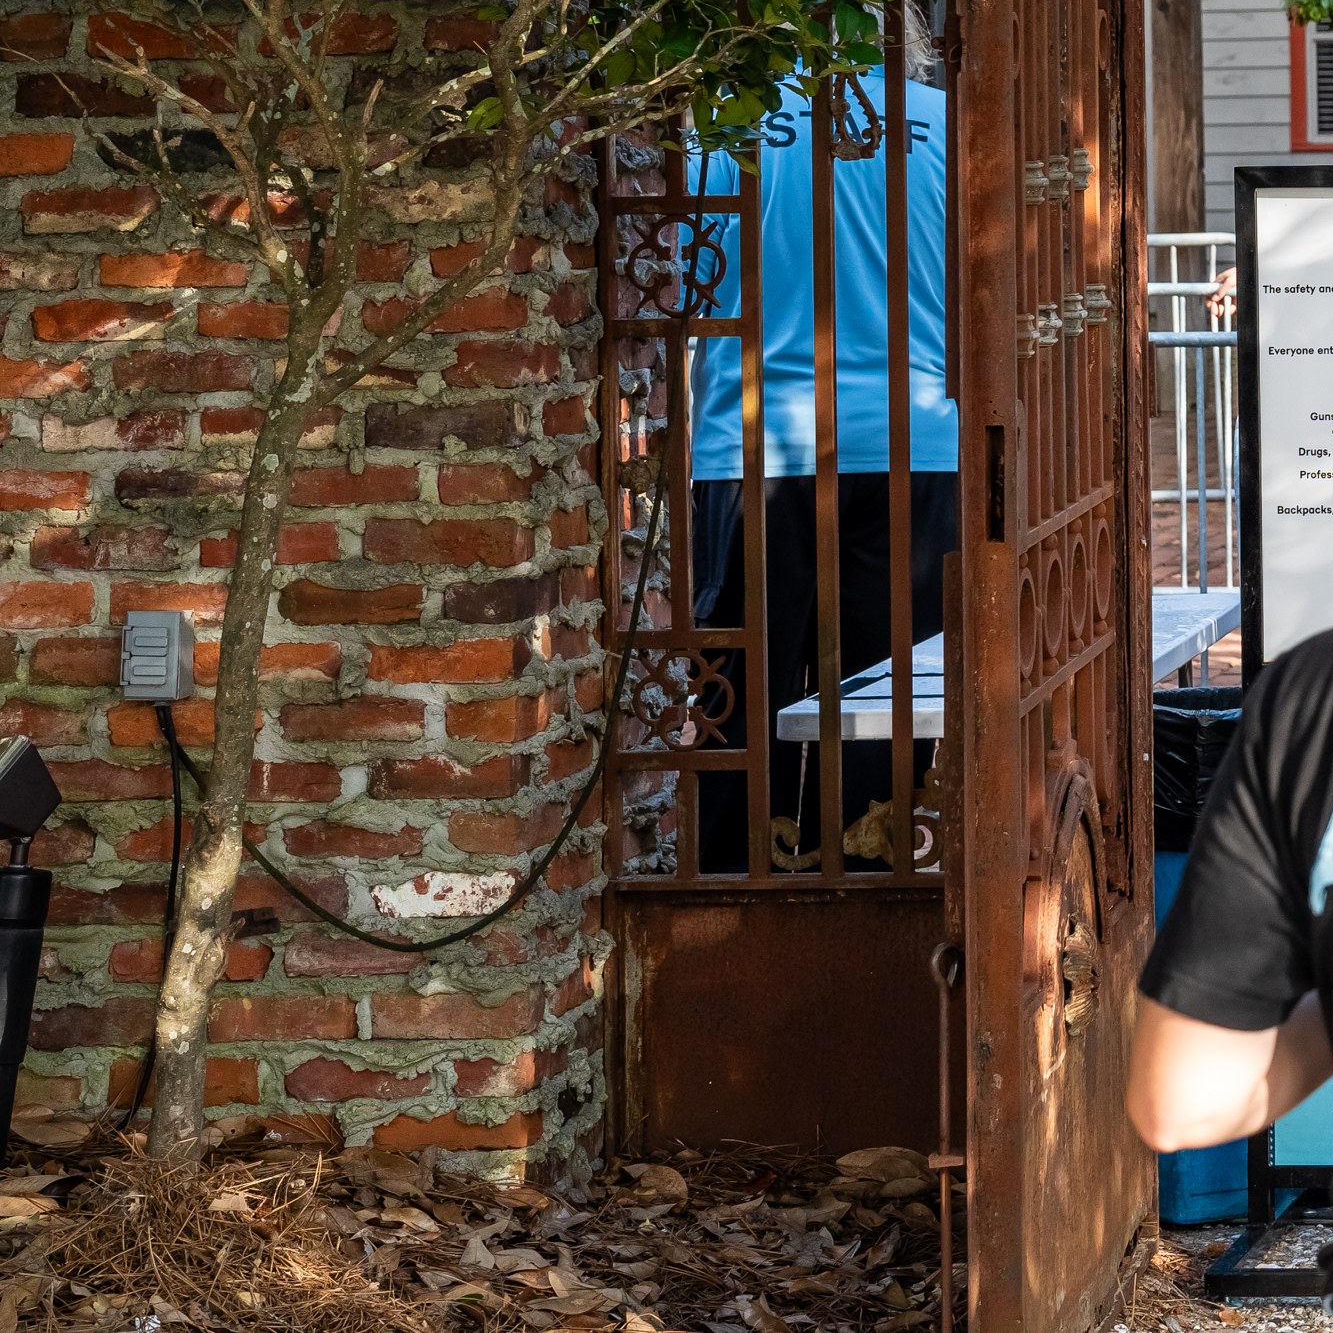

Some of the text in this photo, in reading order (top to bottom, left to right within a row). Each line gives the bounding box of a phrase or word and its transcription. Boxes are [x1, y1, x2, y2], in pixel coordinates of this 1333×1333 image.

[1262, 284, 1282, 294] The
[1284, 284, 1316, 295] safety
[1268, 346, 1315, 357] Everyone
[1298, 447, 1331, 458] Drugs,
